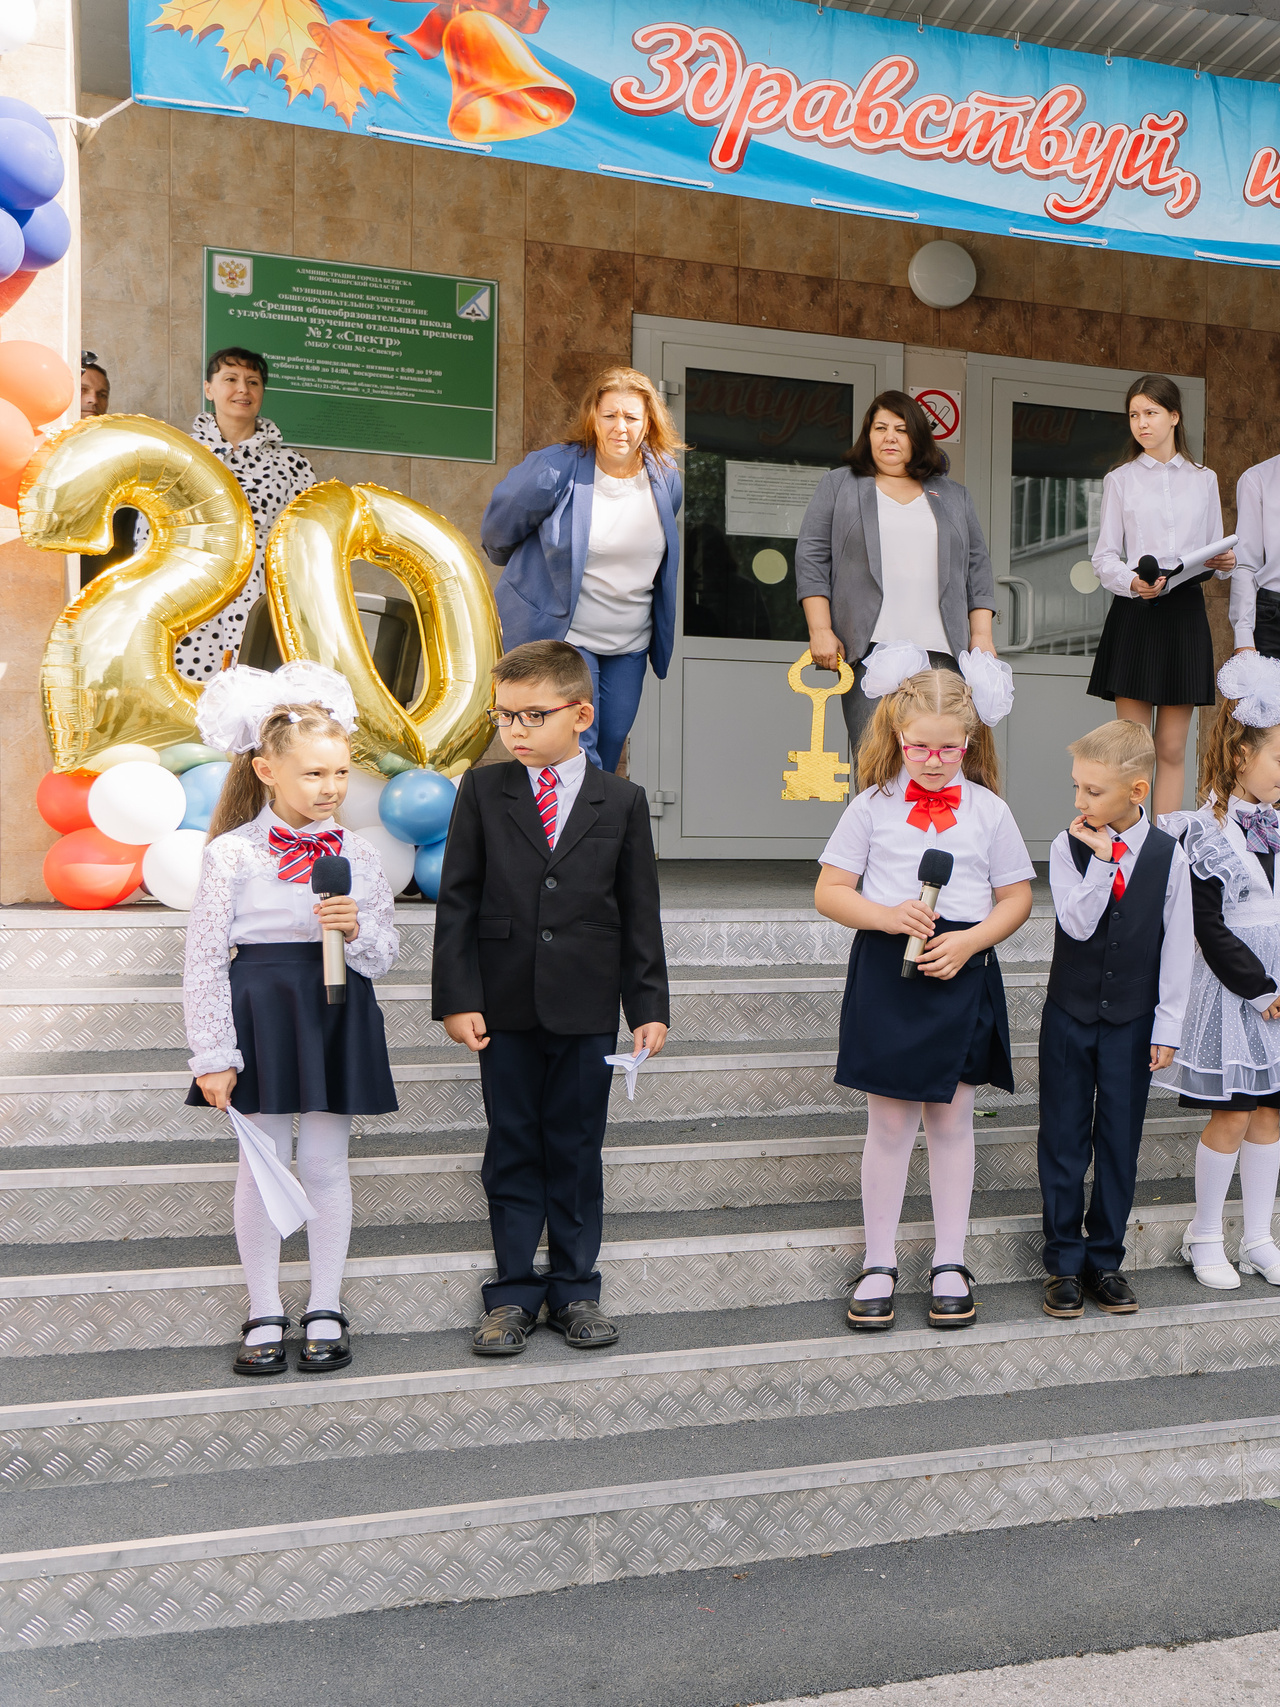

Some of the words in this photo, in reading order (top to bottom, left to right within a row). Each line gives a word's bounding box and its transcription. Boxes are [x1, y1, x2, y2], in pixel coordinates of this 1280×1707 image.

[611, 21, 1200, 225] Здравствуй,
[296, 268, 356, 280] АДМИНИСТРАЦИЯ
[357, 274, 382, 283] ГОРОДА
[383, 277, 412, 287] БЕРДСКА
[308, 275, 368, 288] НОВОСИБИРСКОЙ
[368, 282, 400, 291] ОБЛАСТИ
[278, 293, 375, 309] ОБЩЕОБРАЗОВАТЕЛЬНОЕ
[376, 304, 429, 316] УЧРЕЖДЕНИЕ
[292, 286, 365, 300] МУНИЦИПАЛЬНОЕ
[365, 294, 416, 306] БЮДЖЕТНОЕ
[252, 299, 304, 313] «Средняя
[306, 306, 417, 325] общеобразовательная
[419, 319, 452, 330] школа
[228, 308, 235, 316] с
[237, 309, 308, 323] углубленным
[310, 317, 363, 330] изучением
[365, 324, 420, 336] отдельных
[422, 331, 474, 342] предметов
[304, 340, 330, 349] (МБОУ
[332, 343, 353, 351] СОШ
[306, 326, 322, 338] №
[325, 328, 333, 340] 2
[336, 330, 401, 348] «Спектр»
[262, 352, 286, 361] Режим
[287, 355, 316, 364] работы:
[272, 362, 299, 371] суббота
